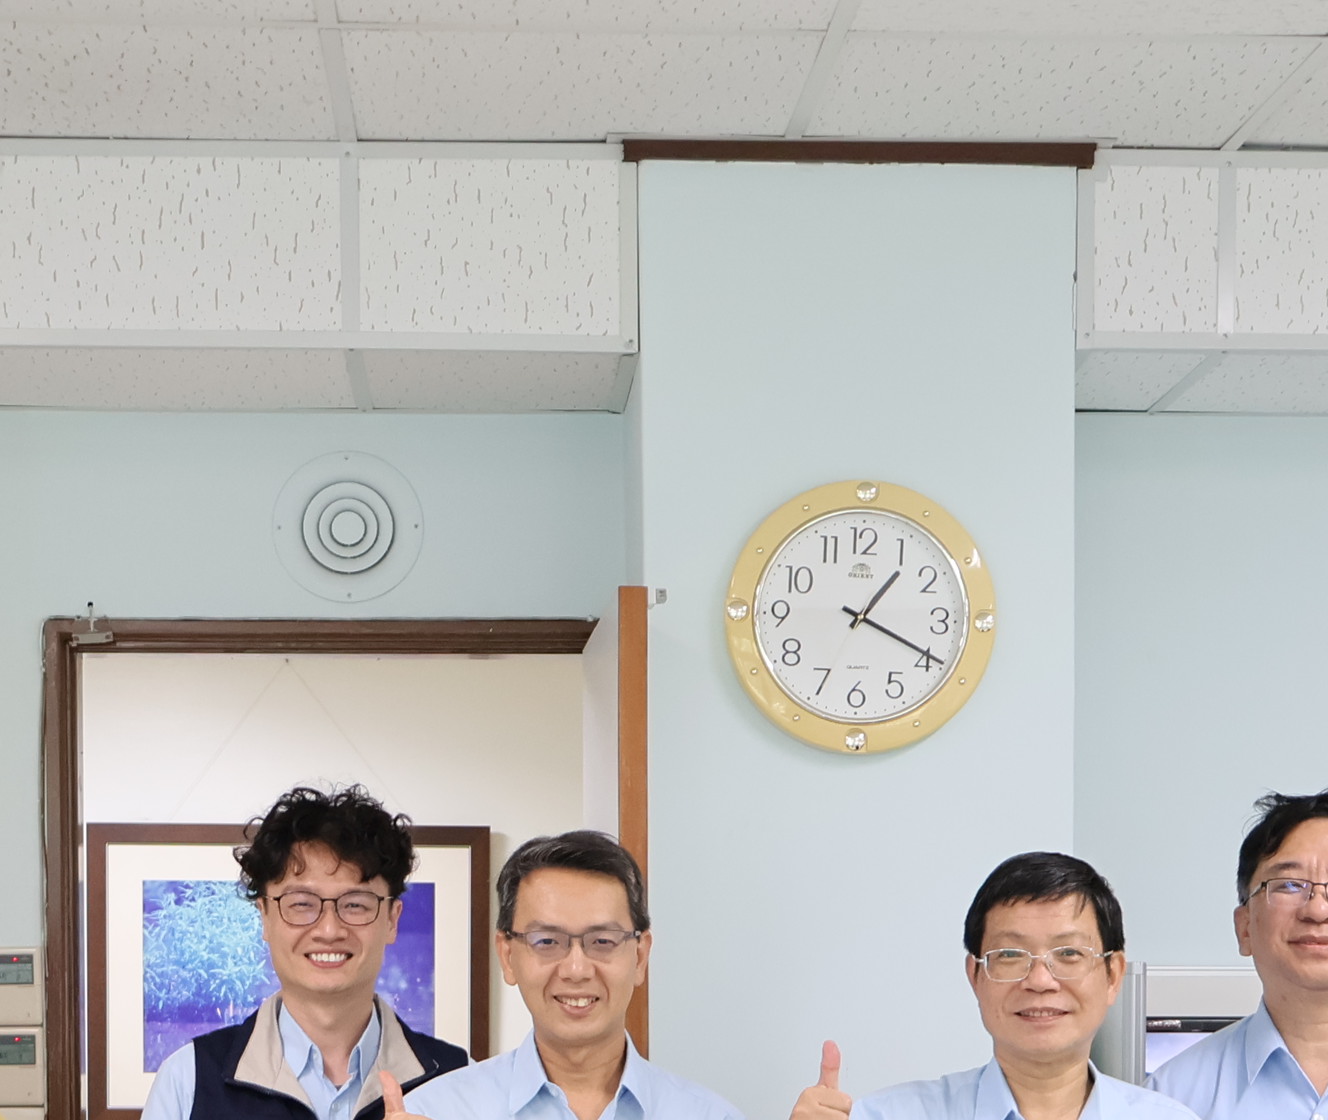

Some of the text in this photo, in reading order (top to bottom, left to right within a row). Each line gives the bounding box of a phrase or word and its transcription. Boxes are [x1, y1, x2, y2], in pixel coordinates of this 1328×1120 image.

[820, 535, 838, 564] 11
[849, 526, 879, 556] 12
[896, 538, 904, 566] 1
[785, 565, 814, 594] 10
[918, 566, 938, 594] 2
[771, 600, 790, 628] 9
[929, 606, 950, 635] 3
[781, 638, 801, 666] 8
[914, 646, 933, 672] 4
[812, 668, 832, 696] 7
[847, 681, 866, 708] 6
[884, 671, 905, 699] 5
